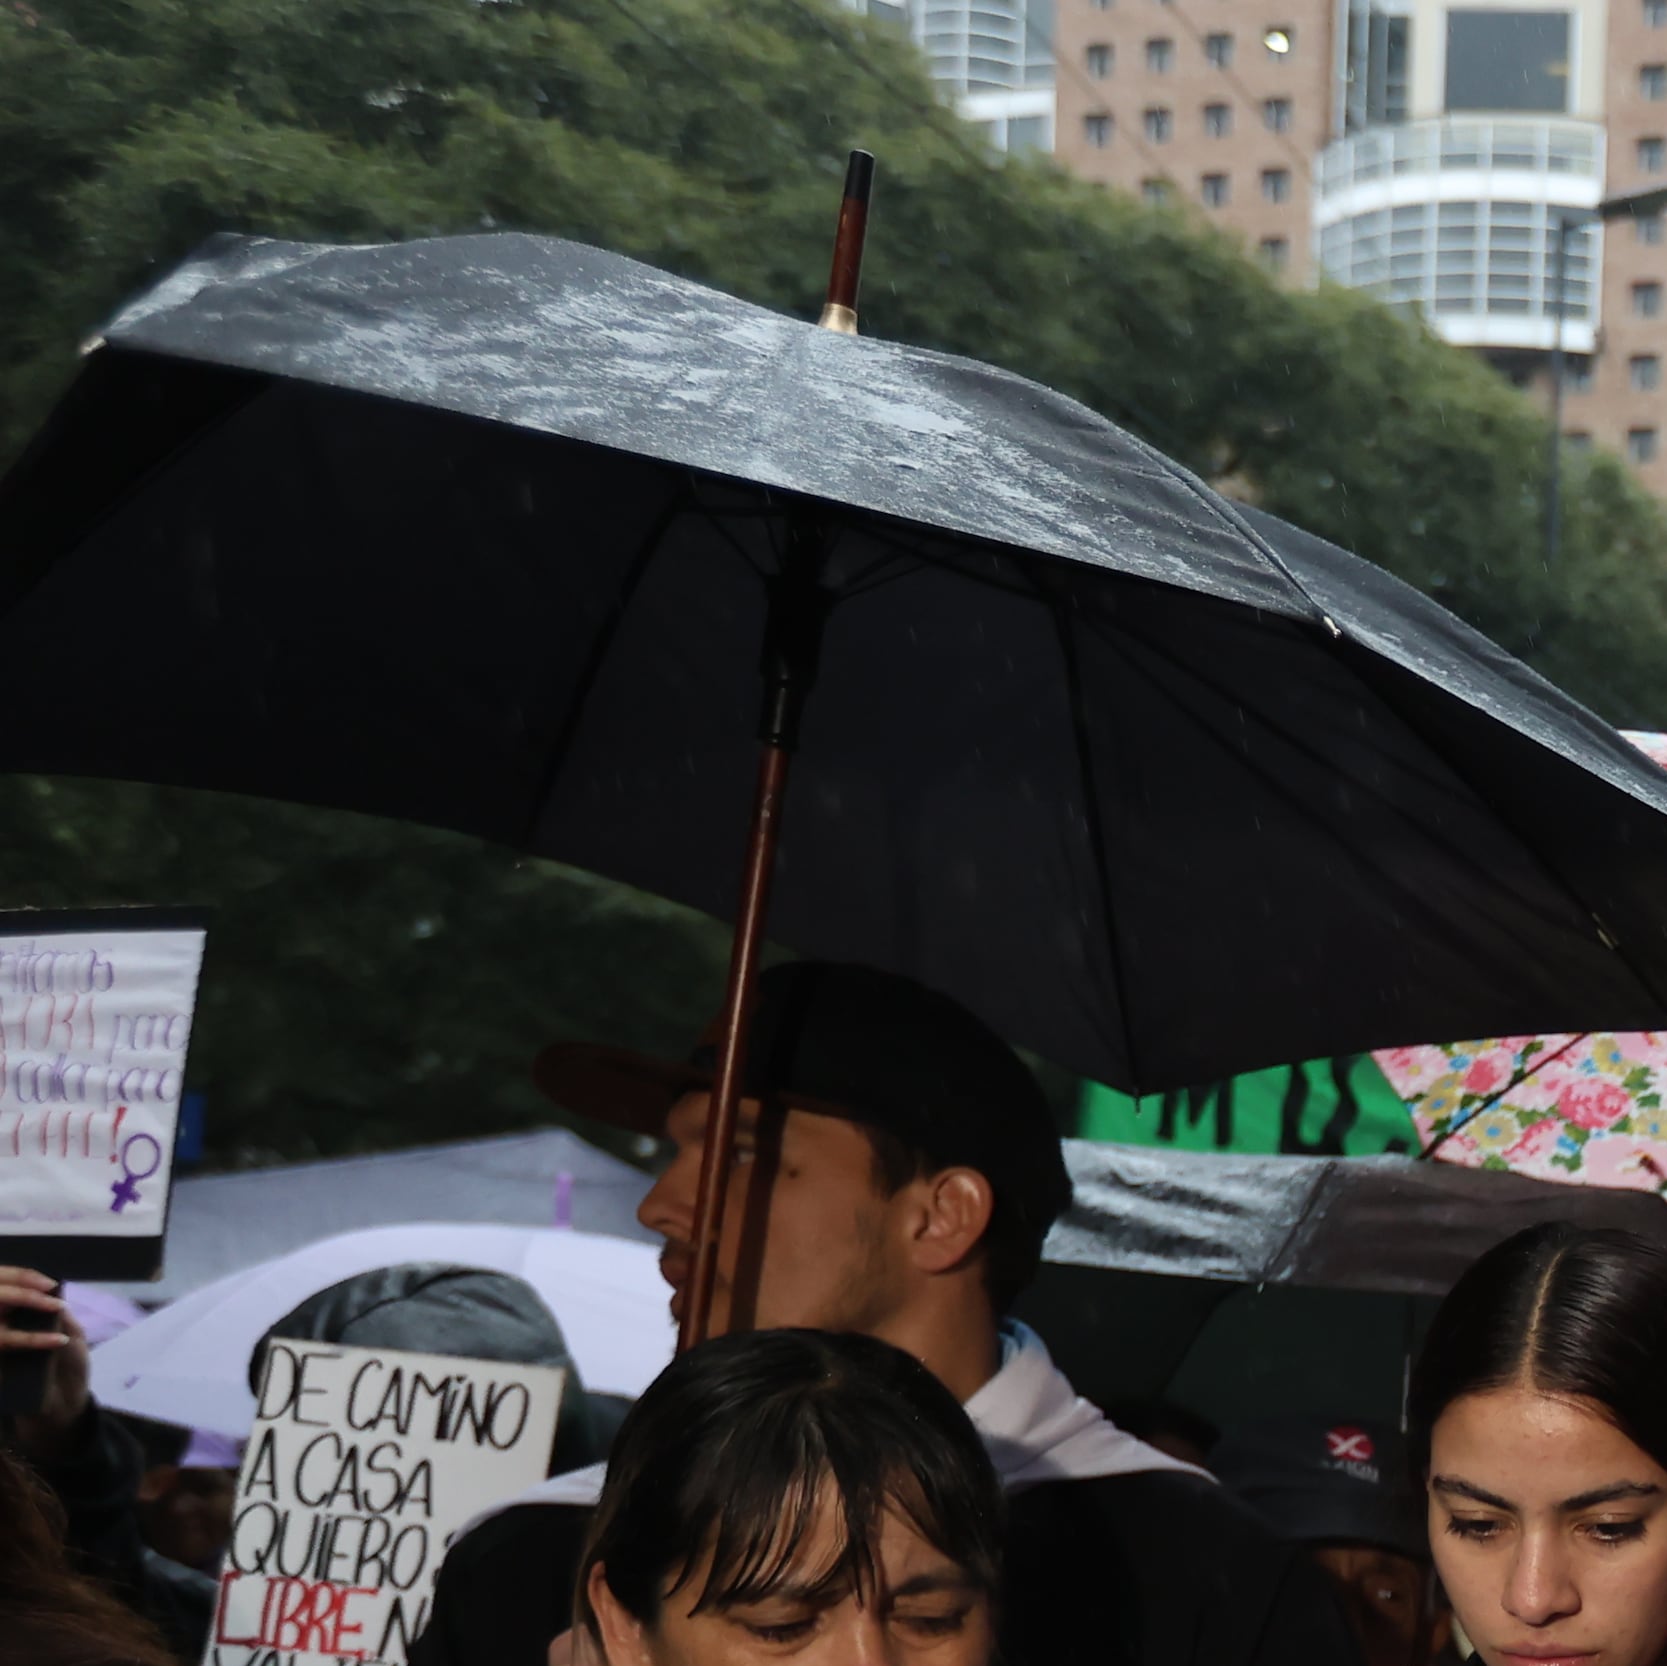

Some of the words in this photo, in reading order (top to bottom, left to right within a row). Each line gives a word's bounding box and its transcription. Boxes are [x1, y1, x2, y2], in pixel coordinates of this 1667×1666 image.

[256, 1345, 343, 1427] DE
[244, 1427, 278, 1501] A
[294, 1432, 432, 1518] CASA
[216, 1569, 379, 1660] LIBRE
[377, 1594, 430, 1660] N
